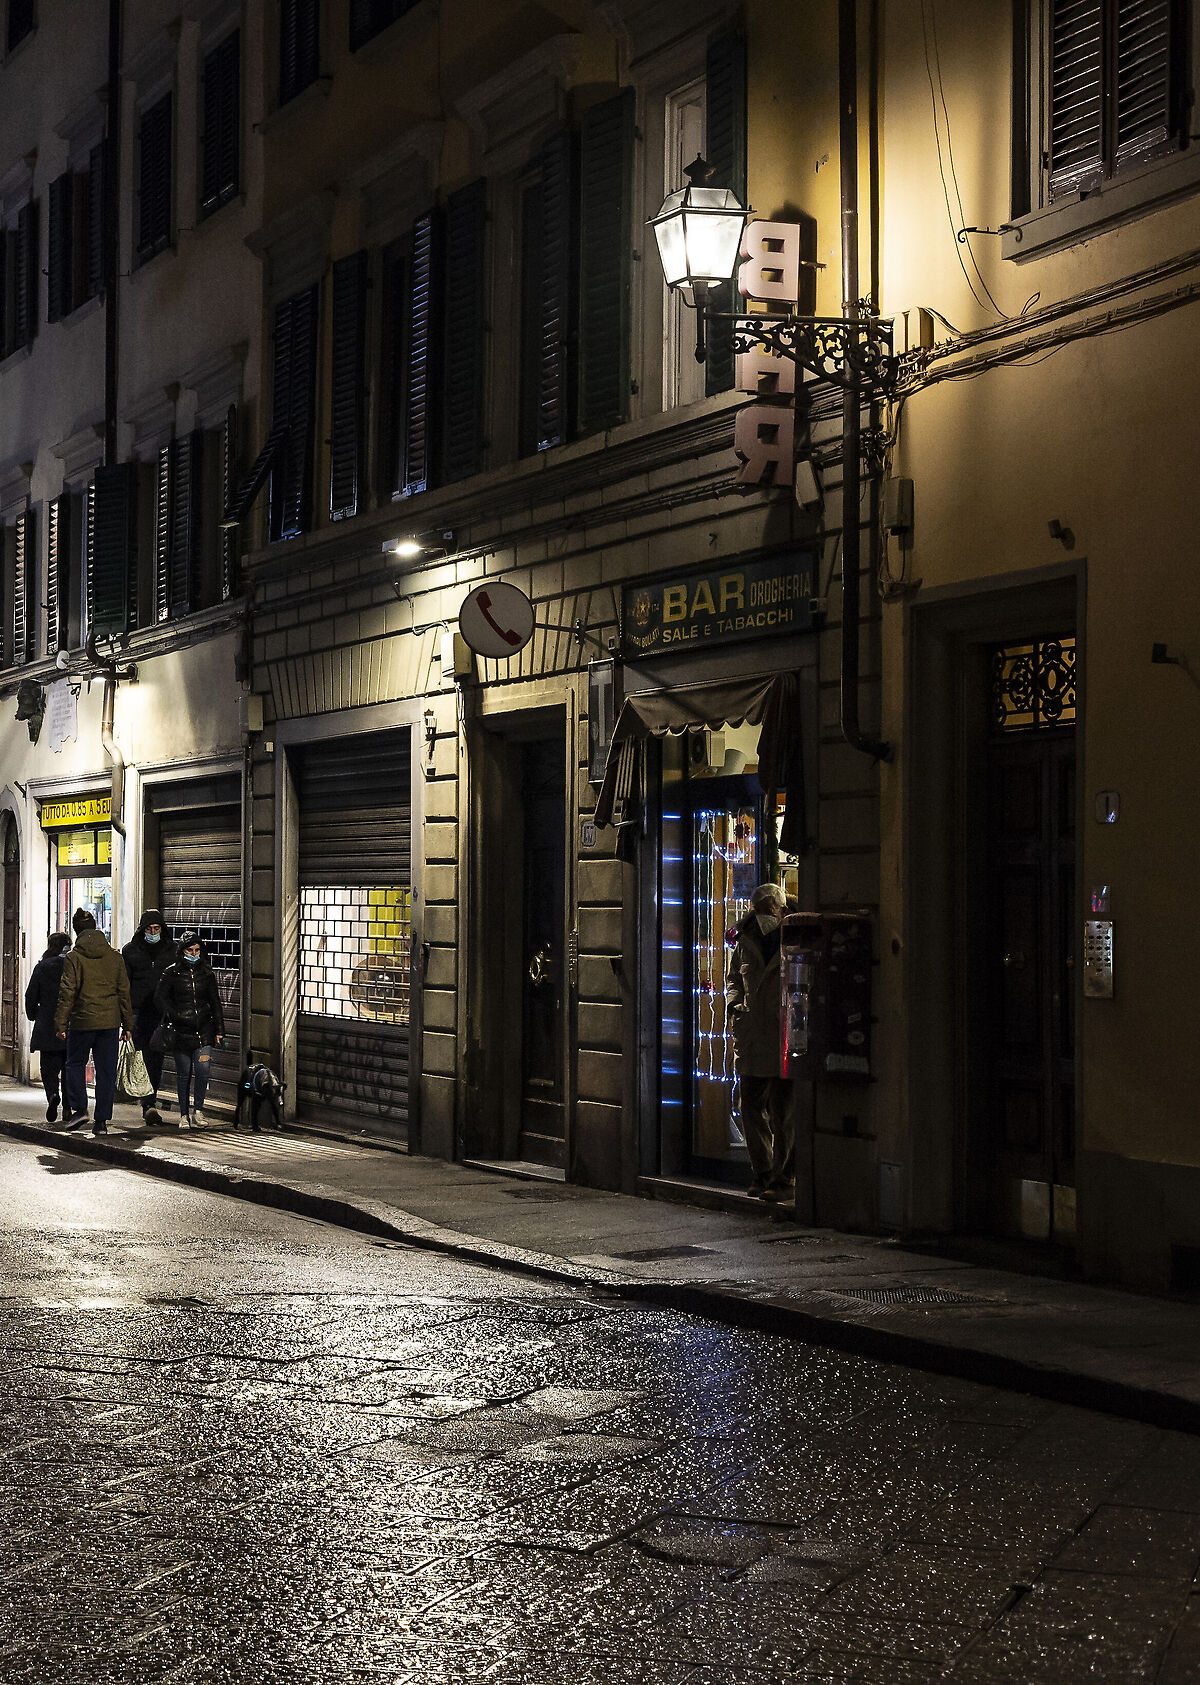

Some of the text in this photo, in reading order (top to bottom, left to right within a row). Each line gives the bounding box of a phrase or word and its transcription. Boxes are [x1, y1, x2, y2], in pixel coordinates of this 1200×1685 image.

[662, 571, 812, 624] BAR DROGHERIA
[662, 608, 794, 643] SALE E TABACCHI
[42, 805, 60, 820] TUTTO
[89, 801, 95, 816] A
[96, 798, 102, 815] 5
[102, 799, 111, 814] EU
